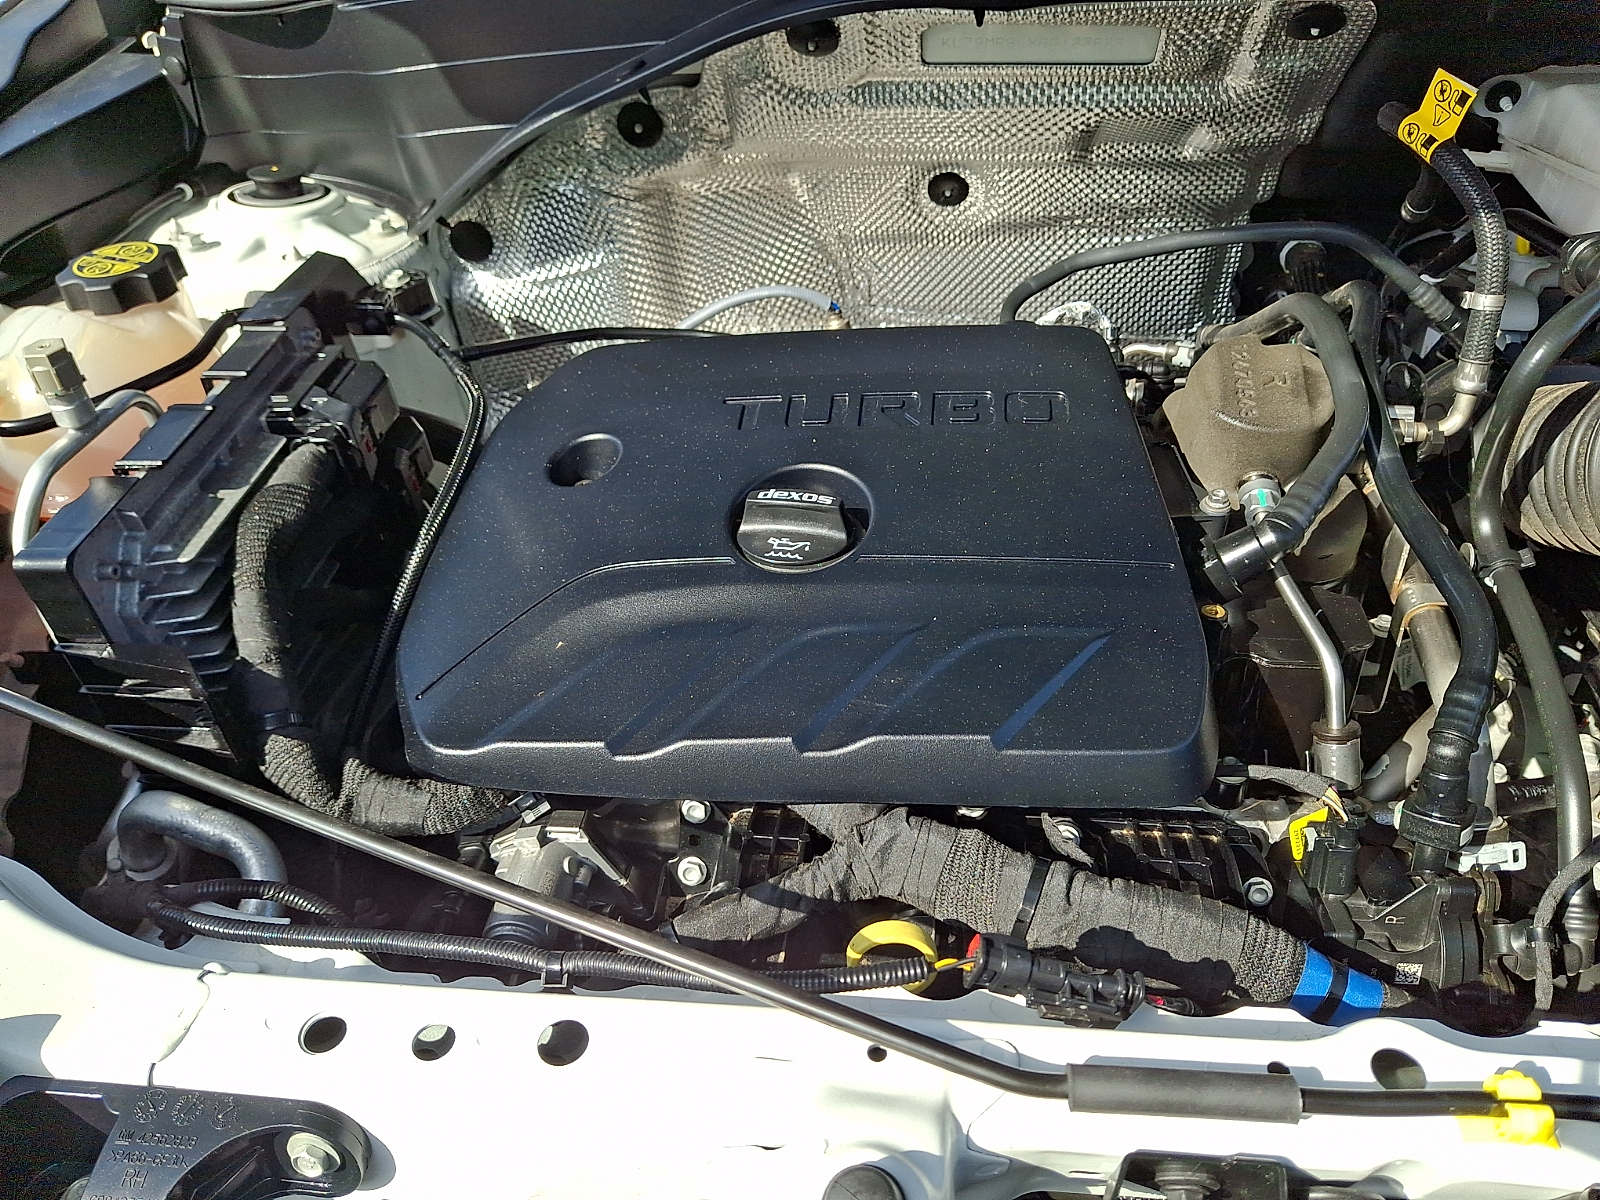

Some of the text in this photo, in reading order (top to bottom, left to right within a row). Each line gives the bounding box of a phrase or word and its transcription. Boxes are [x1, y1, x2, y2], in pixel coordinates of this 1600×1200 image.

[723, 390, 1070, 431] TURBO
[757, 488, 836, 506] dexos
[1384, 915, 1406, 925] R
[121, 1167, 149, 1190] RH
